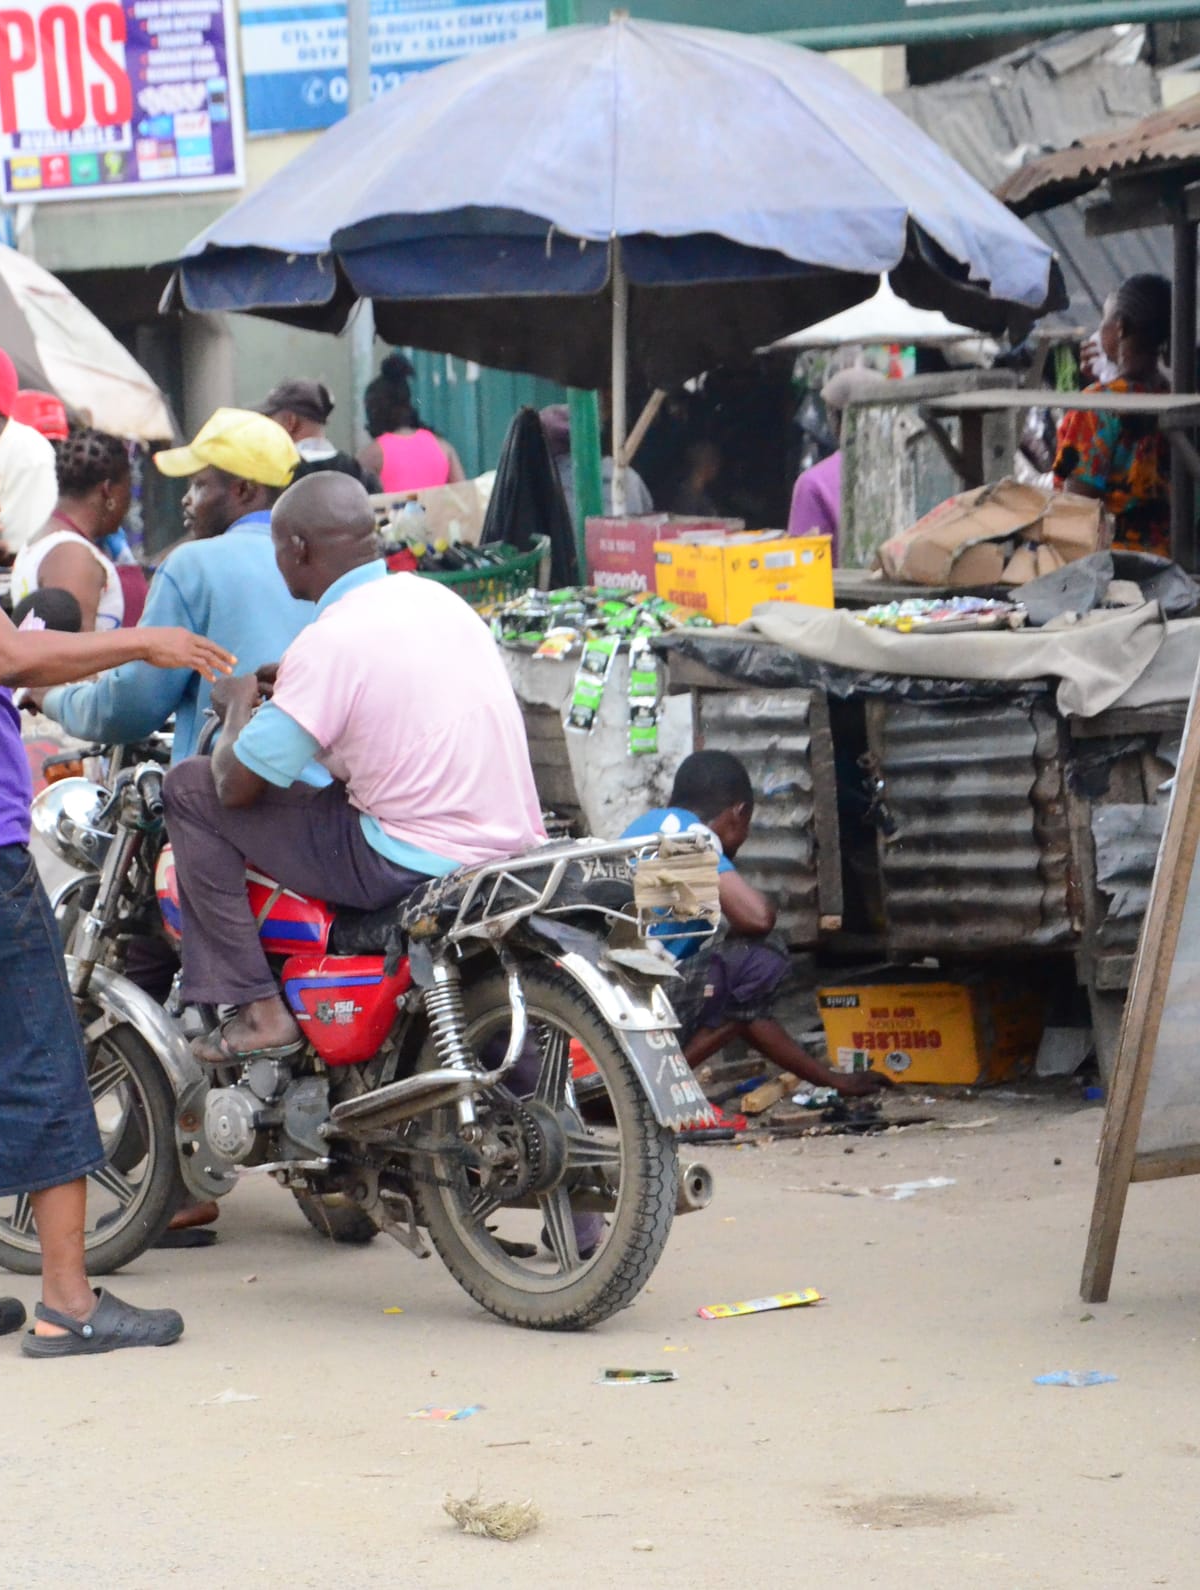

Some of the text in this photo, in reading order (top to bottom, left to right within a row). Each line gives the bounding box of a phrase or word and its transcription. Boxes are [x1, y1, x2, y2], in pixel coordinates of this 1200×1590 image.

[368, 41, 403, 56] OTV
[826, 995, 857, 1007] Minis
[852, 1029, 943, 1050] CHELSEA
